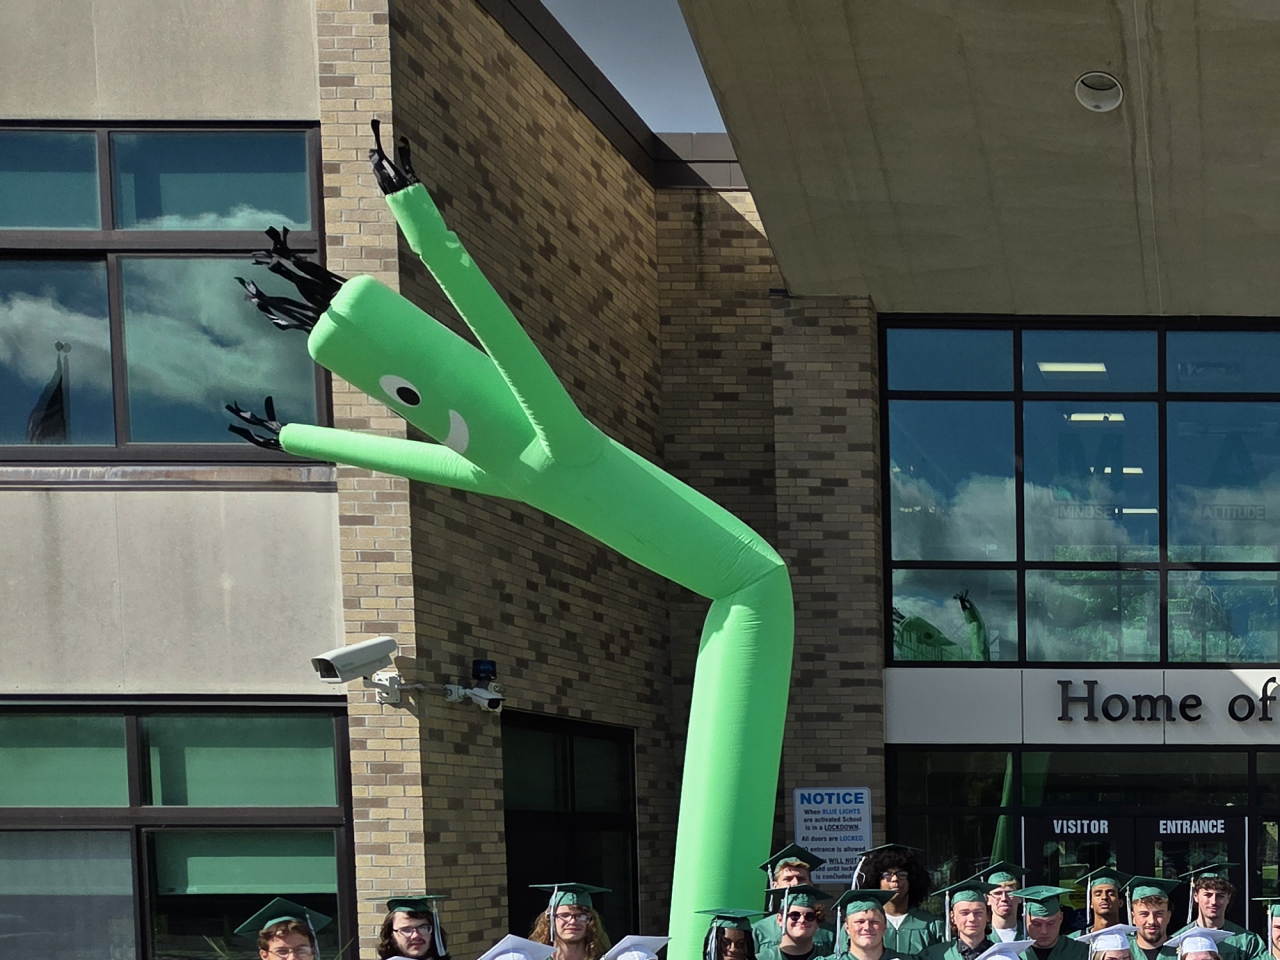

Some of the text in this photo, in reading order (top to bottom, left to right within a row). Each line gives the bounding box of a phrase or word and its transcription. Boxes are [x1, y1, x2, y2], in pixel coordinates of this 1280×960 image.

[1202, 505, 1265, 520] ATTITUDE
[1057, 679, 1203, 722] Home
[1228, 676, 1278, 722] of
[800, 792, 864, 804] NOTICE
[1053, 819, 1226, 834] VISITOR ENTRANCE
